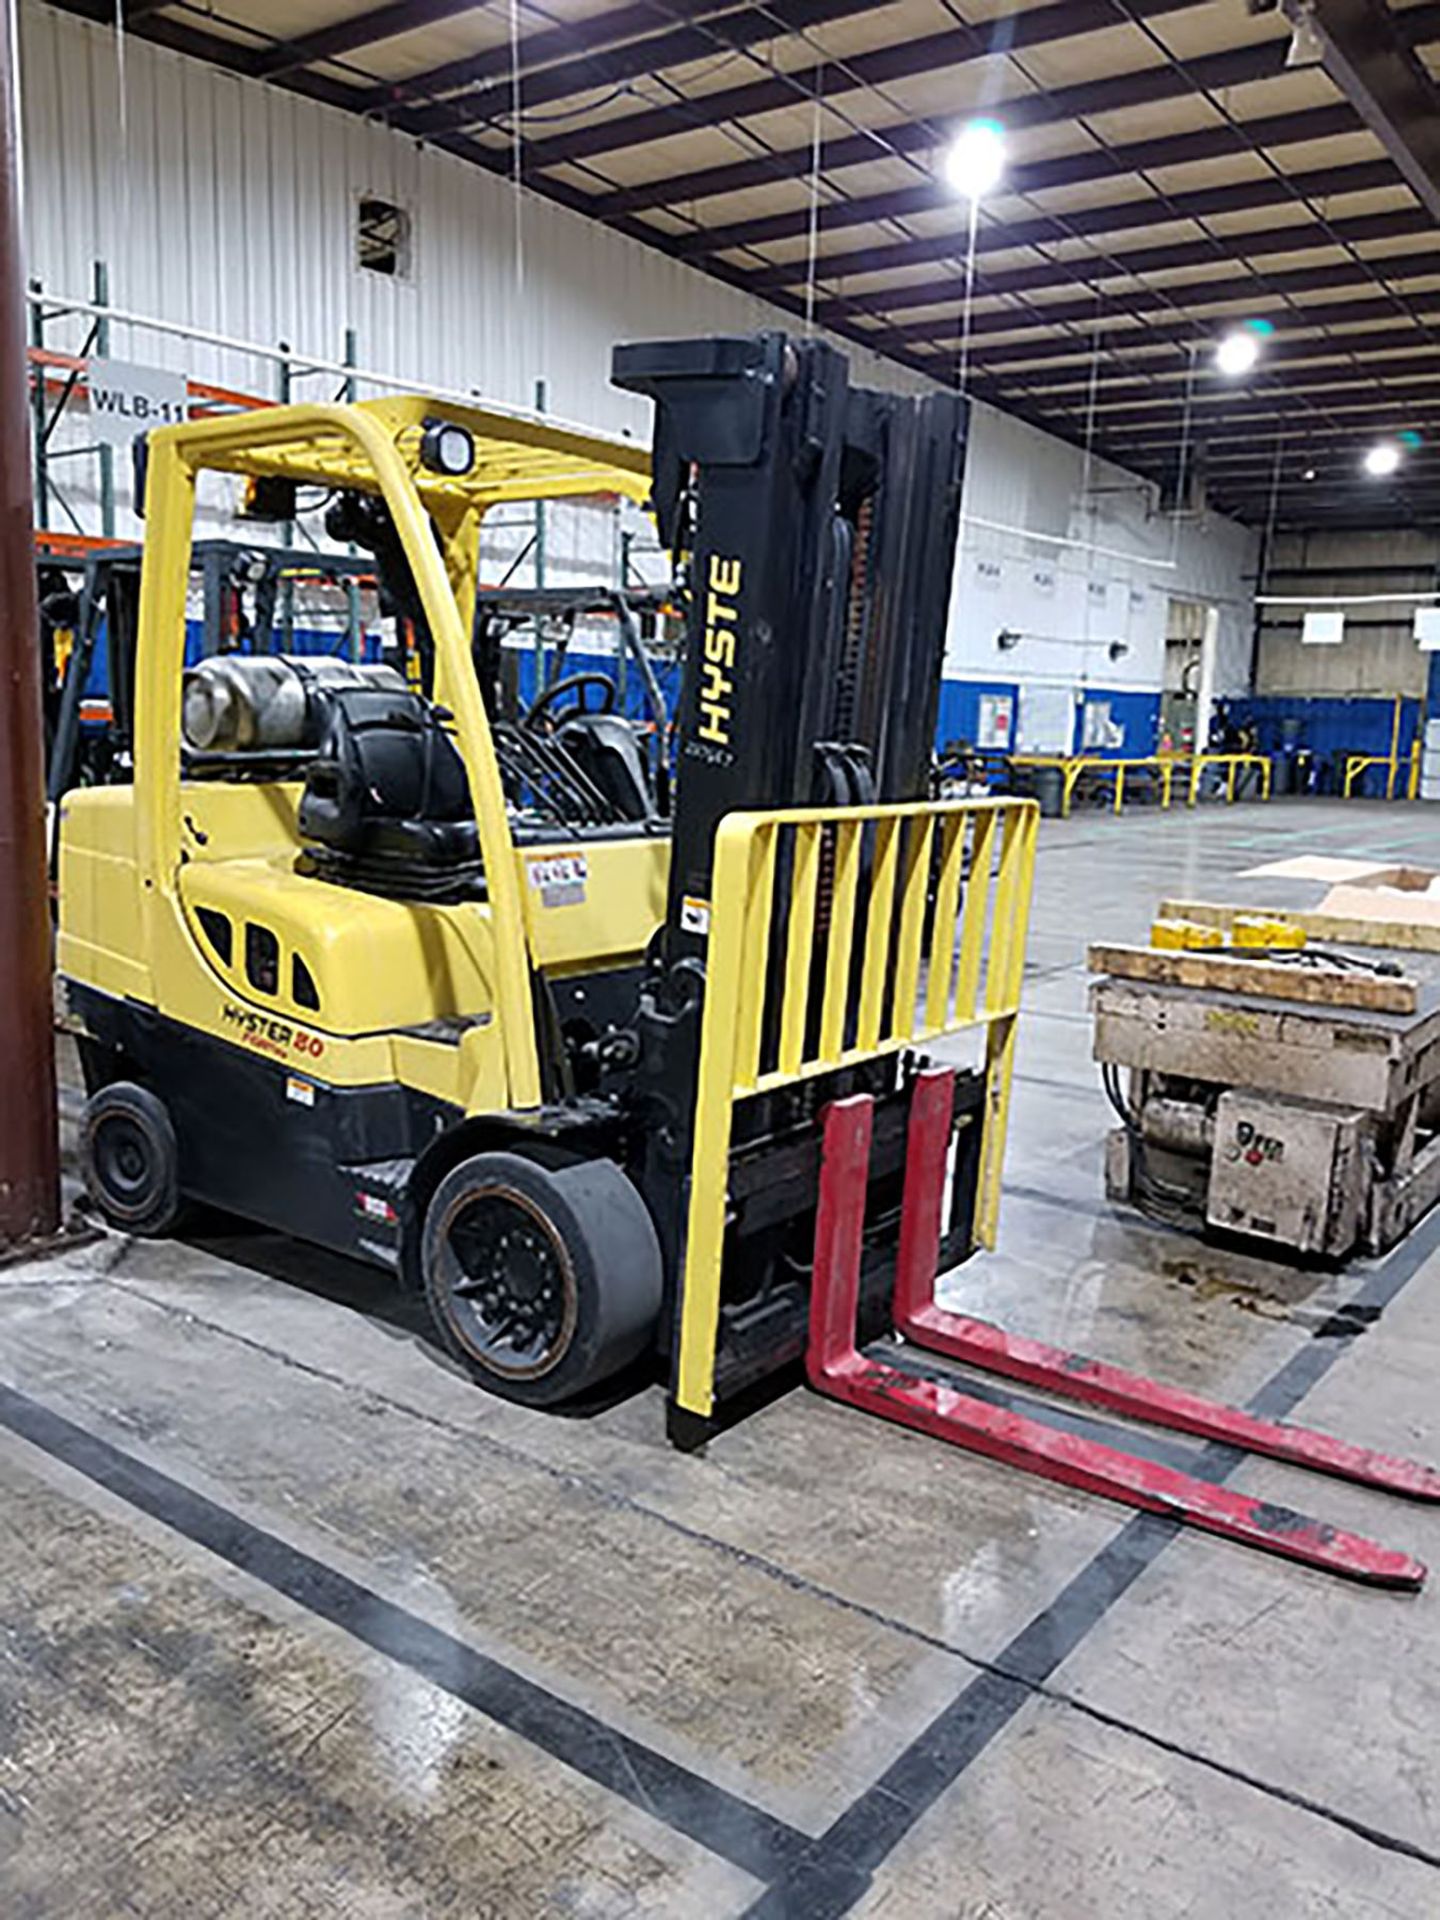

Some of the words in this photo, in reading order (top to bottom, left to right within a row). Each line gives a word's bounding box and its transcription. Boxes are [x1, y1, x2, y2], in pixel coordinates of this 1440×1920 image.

[92, 388, 184, 423] WLB-11
[699, 555, 742, 744] HYSTE
[222, 1005, 292, 1043] HYSTER
[293, 1030, 325, 1058] 80
